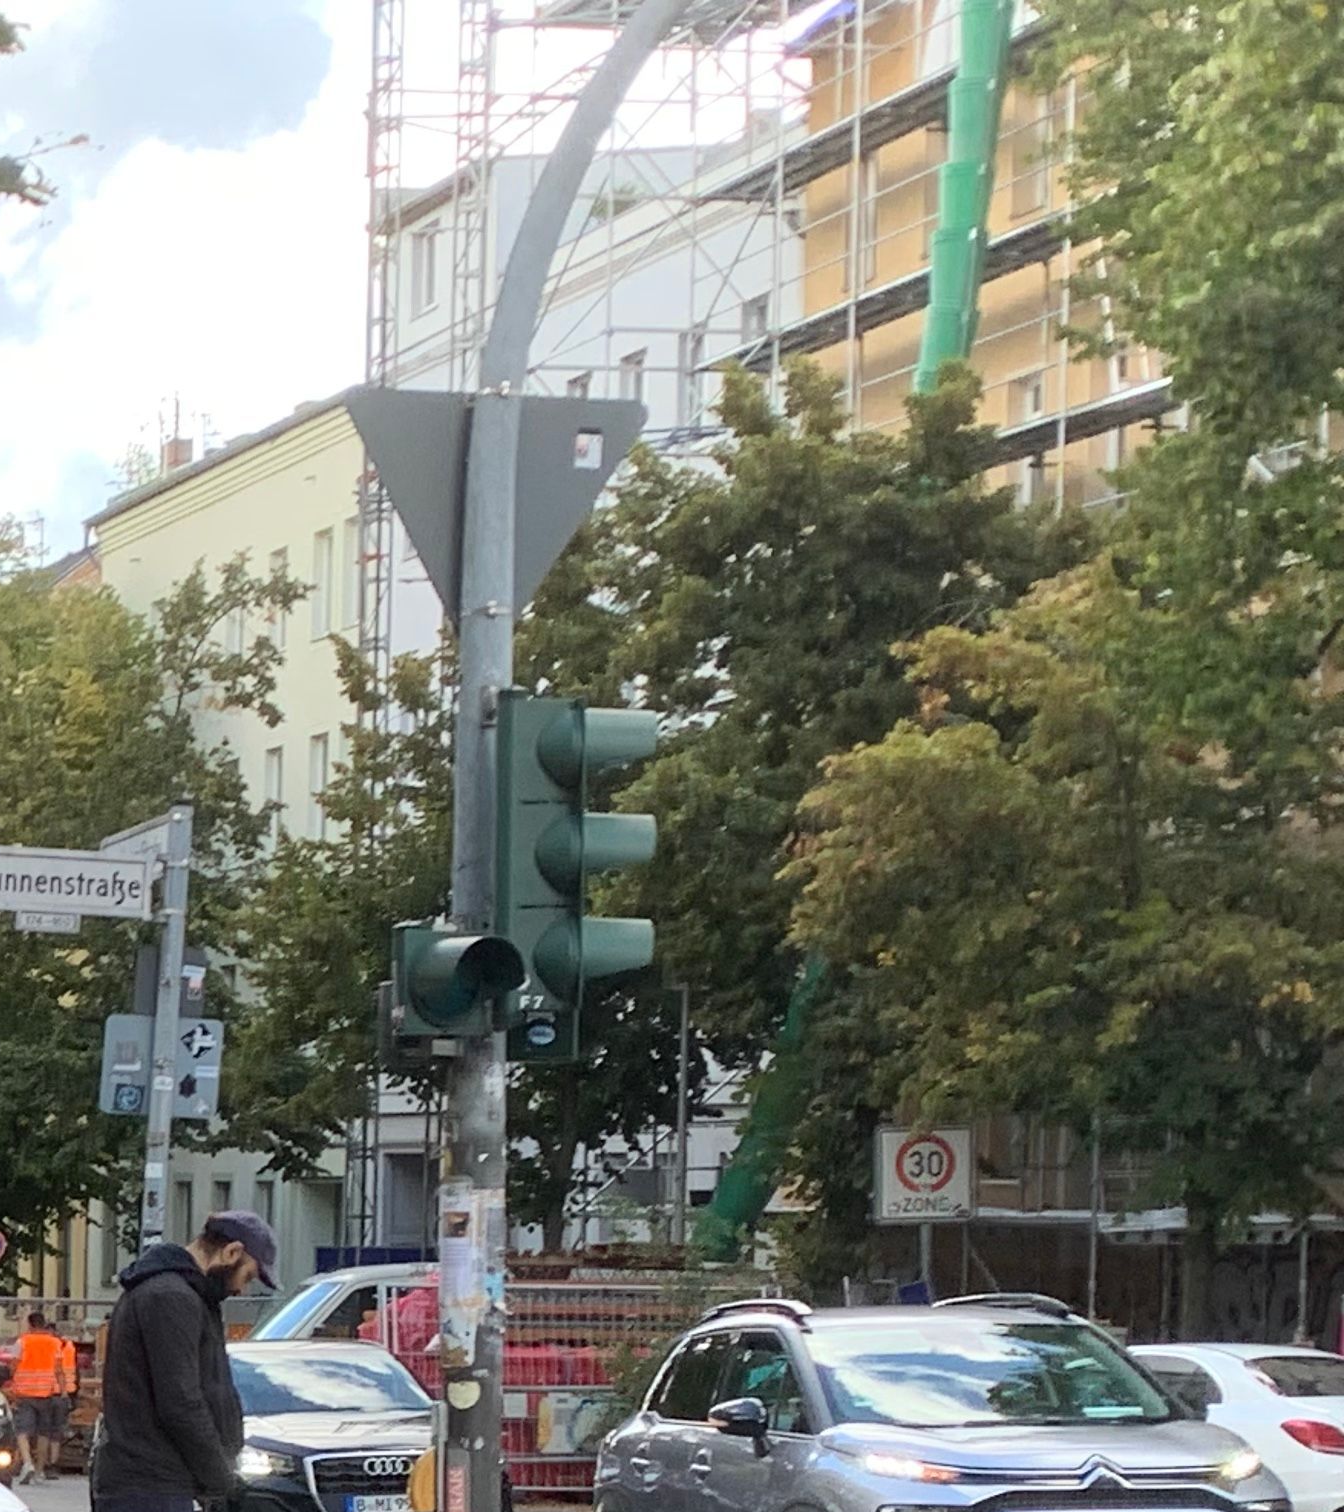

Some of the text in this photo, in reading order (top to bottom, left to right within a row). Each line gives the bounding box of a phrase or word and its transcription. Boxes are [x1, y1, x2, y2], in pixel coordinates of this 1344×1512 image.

[909, 1150, 944, 1178] 30
[902, 1196, 950, 1213] ZONE
[356, 1499, 367, 1512] B
